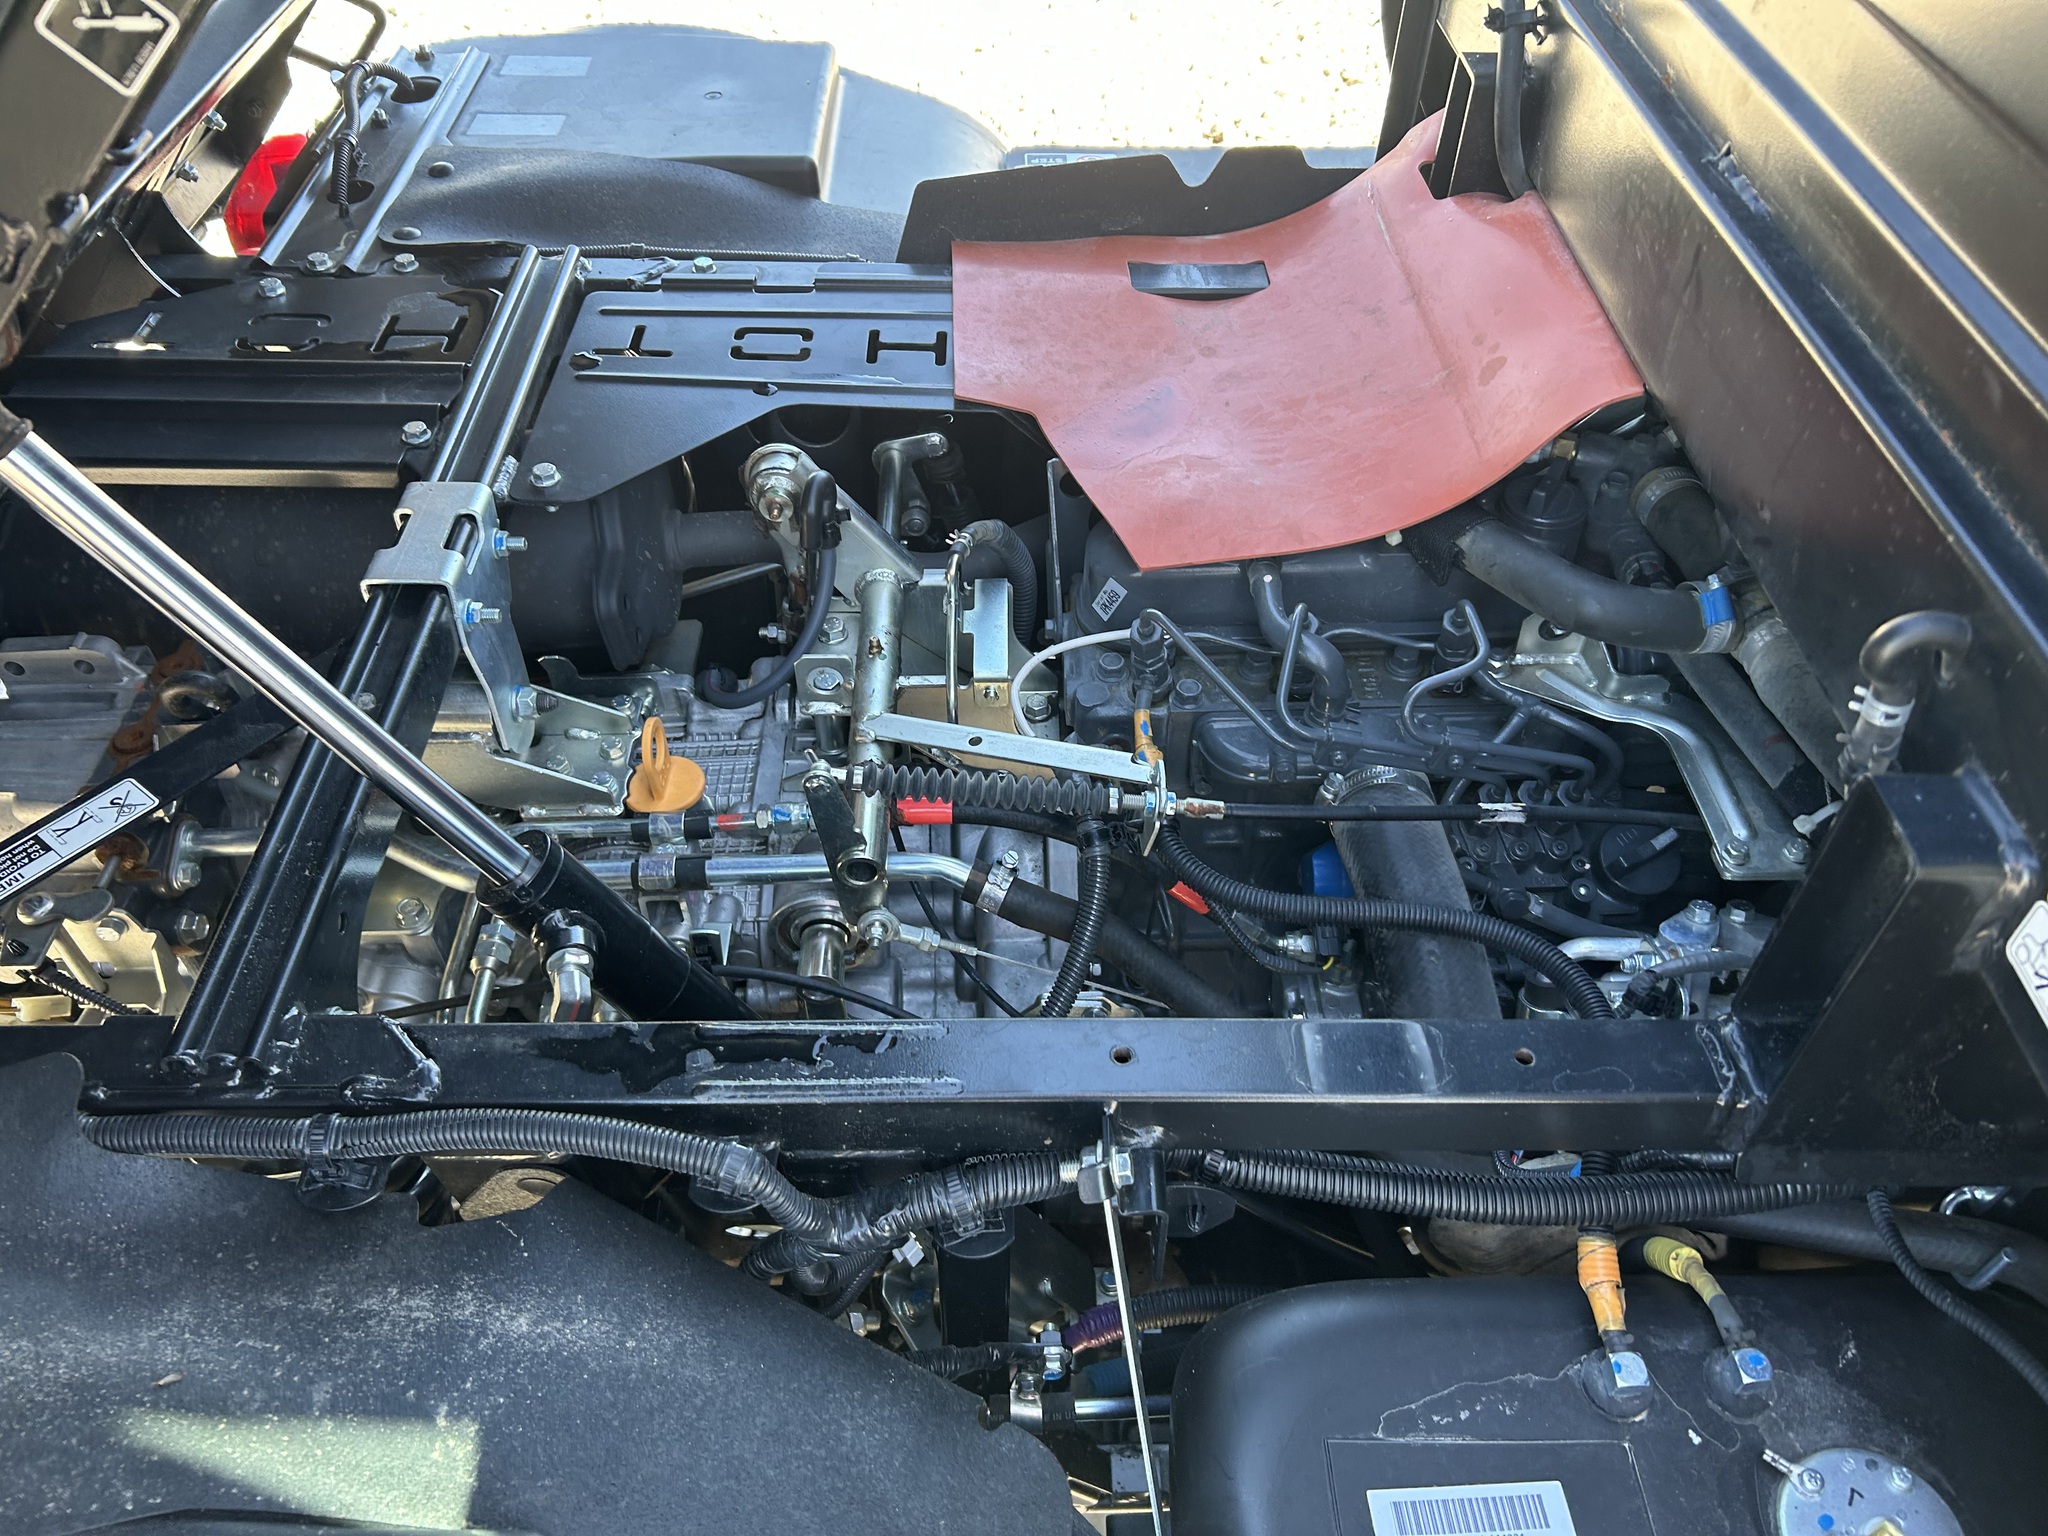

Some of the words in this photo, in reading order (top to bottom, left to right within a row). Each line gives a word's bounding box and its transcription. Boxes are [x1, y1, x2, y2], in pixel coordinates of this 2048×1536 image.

[592, 324, 948, 366] HOT
[12, 839, 35, 854] when
[27, 844, 41, 853] Do
[12, 852, 27, 862] not
[30, 849, 46, 859] TO
[0, 857, 29, 878] AVOID
